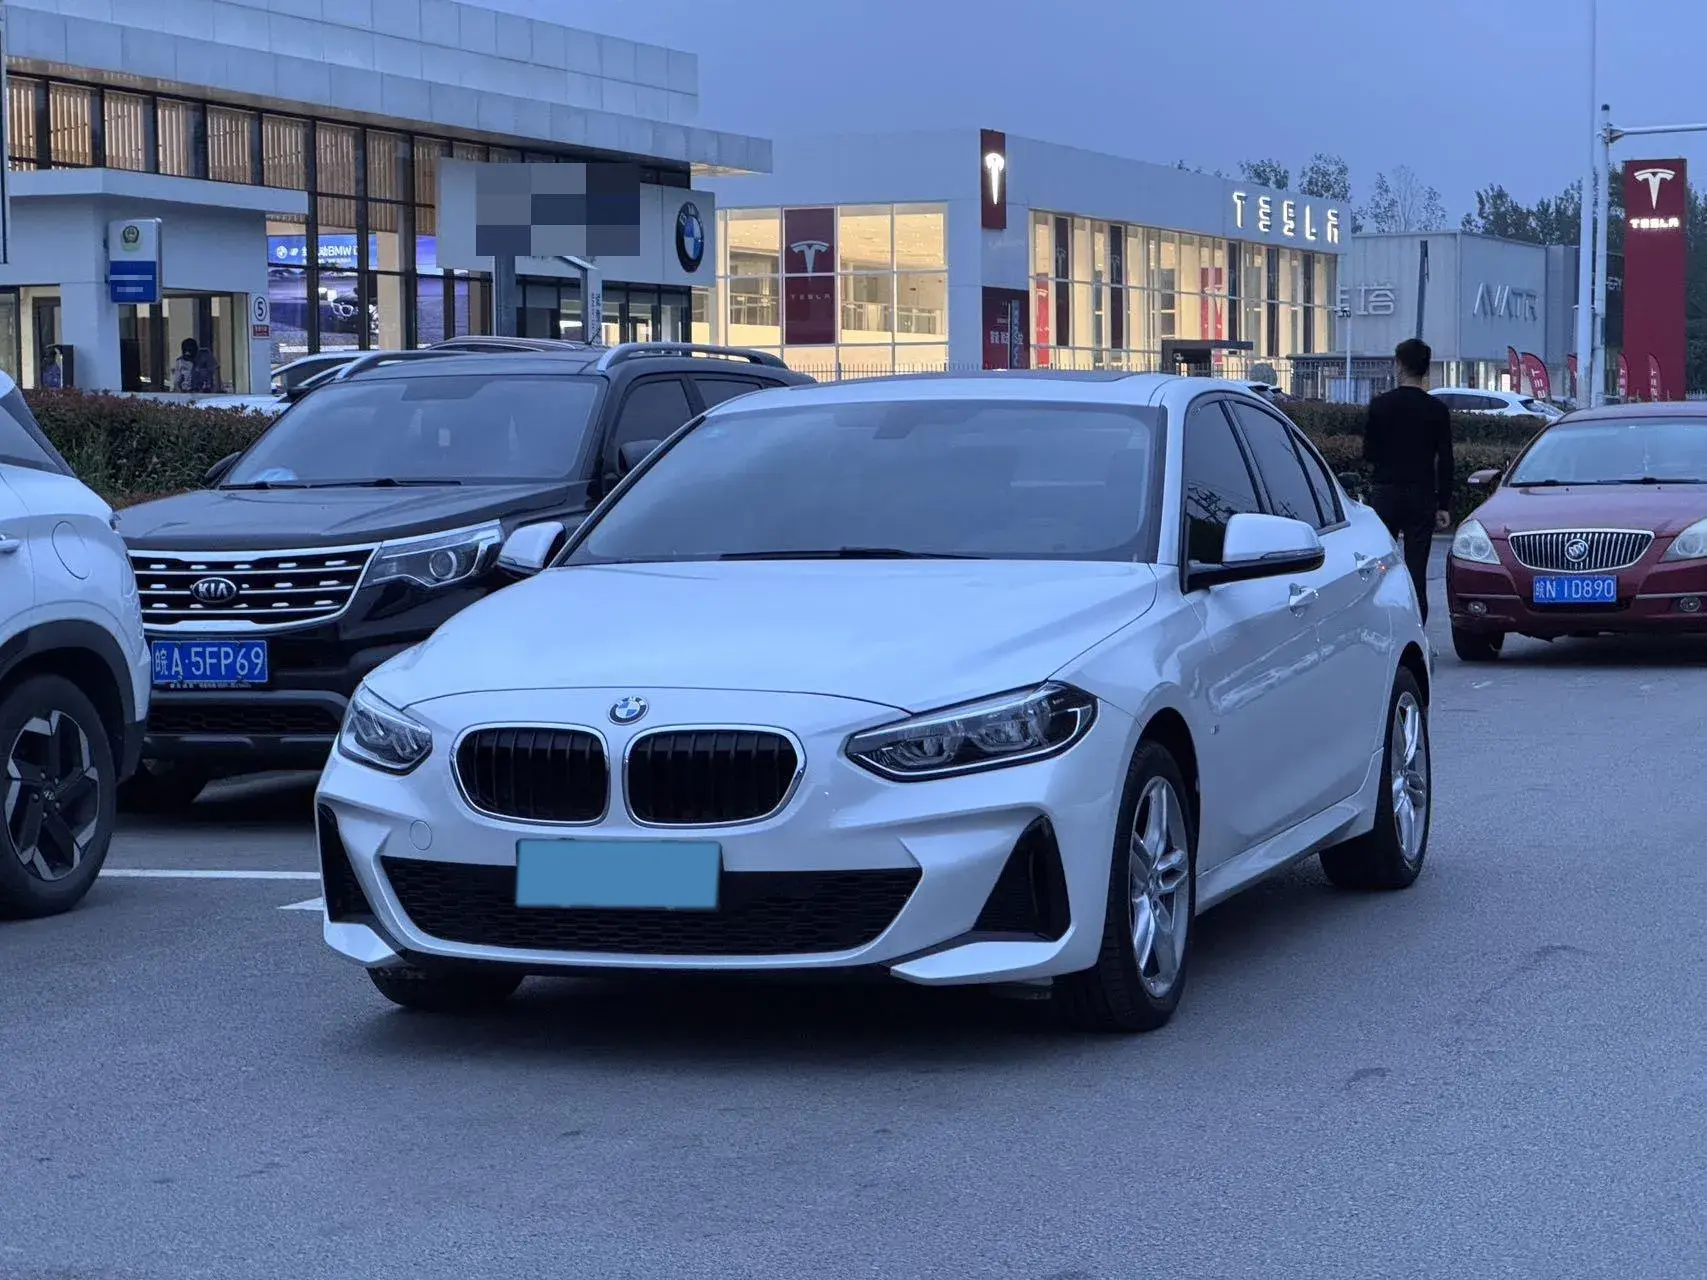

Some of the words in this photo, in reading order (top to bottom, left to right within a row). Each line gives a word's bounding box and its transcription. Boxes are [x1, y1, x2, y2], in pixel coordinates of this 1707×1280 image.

[1233, 191, 1339, 244] TESLA
[1629, 217, 1680, 229] TESLA
[198, 583, 228, 598] KIA
